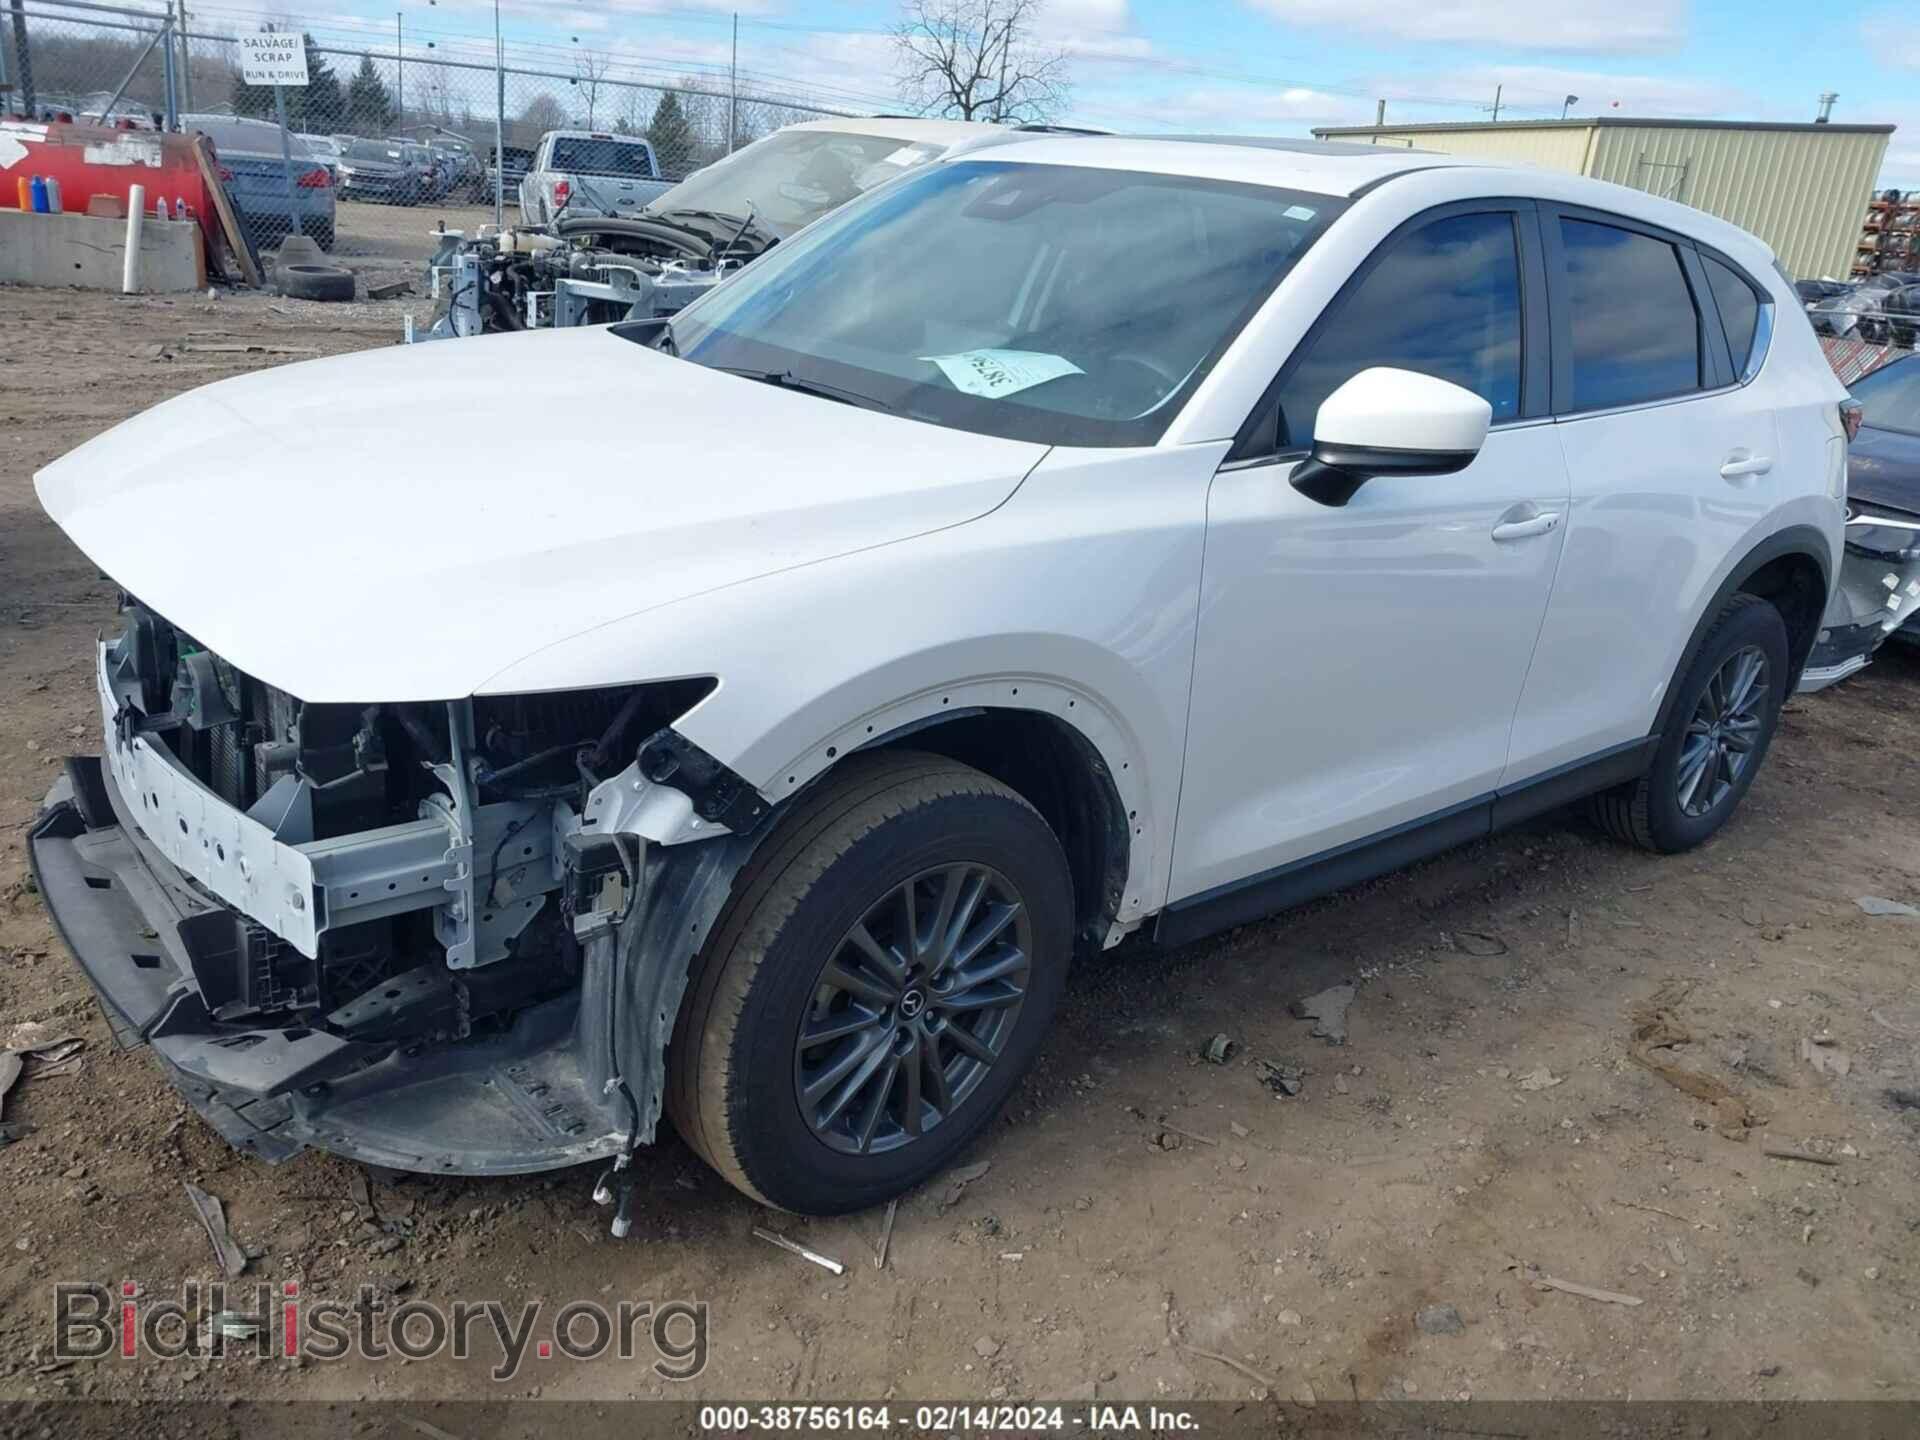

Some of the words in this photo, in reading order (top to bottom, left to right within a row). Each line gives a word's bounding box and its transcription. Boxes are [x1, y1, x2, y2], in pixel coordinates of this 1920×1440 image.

[243, 37, 298, 48] SALVAGE/
[254, 52, 292, 62] SCRAP
[246, 70, 265, 79] RUN
[268, 71, 275, 79] &
[278, 71, 305, 80] DRIVE
